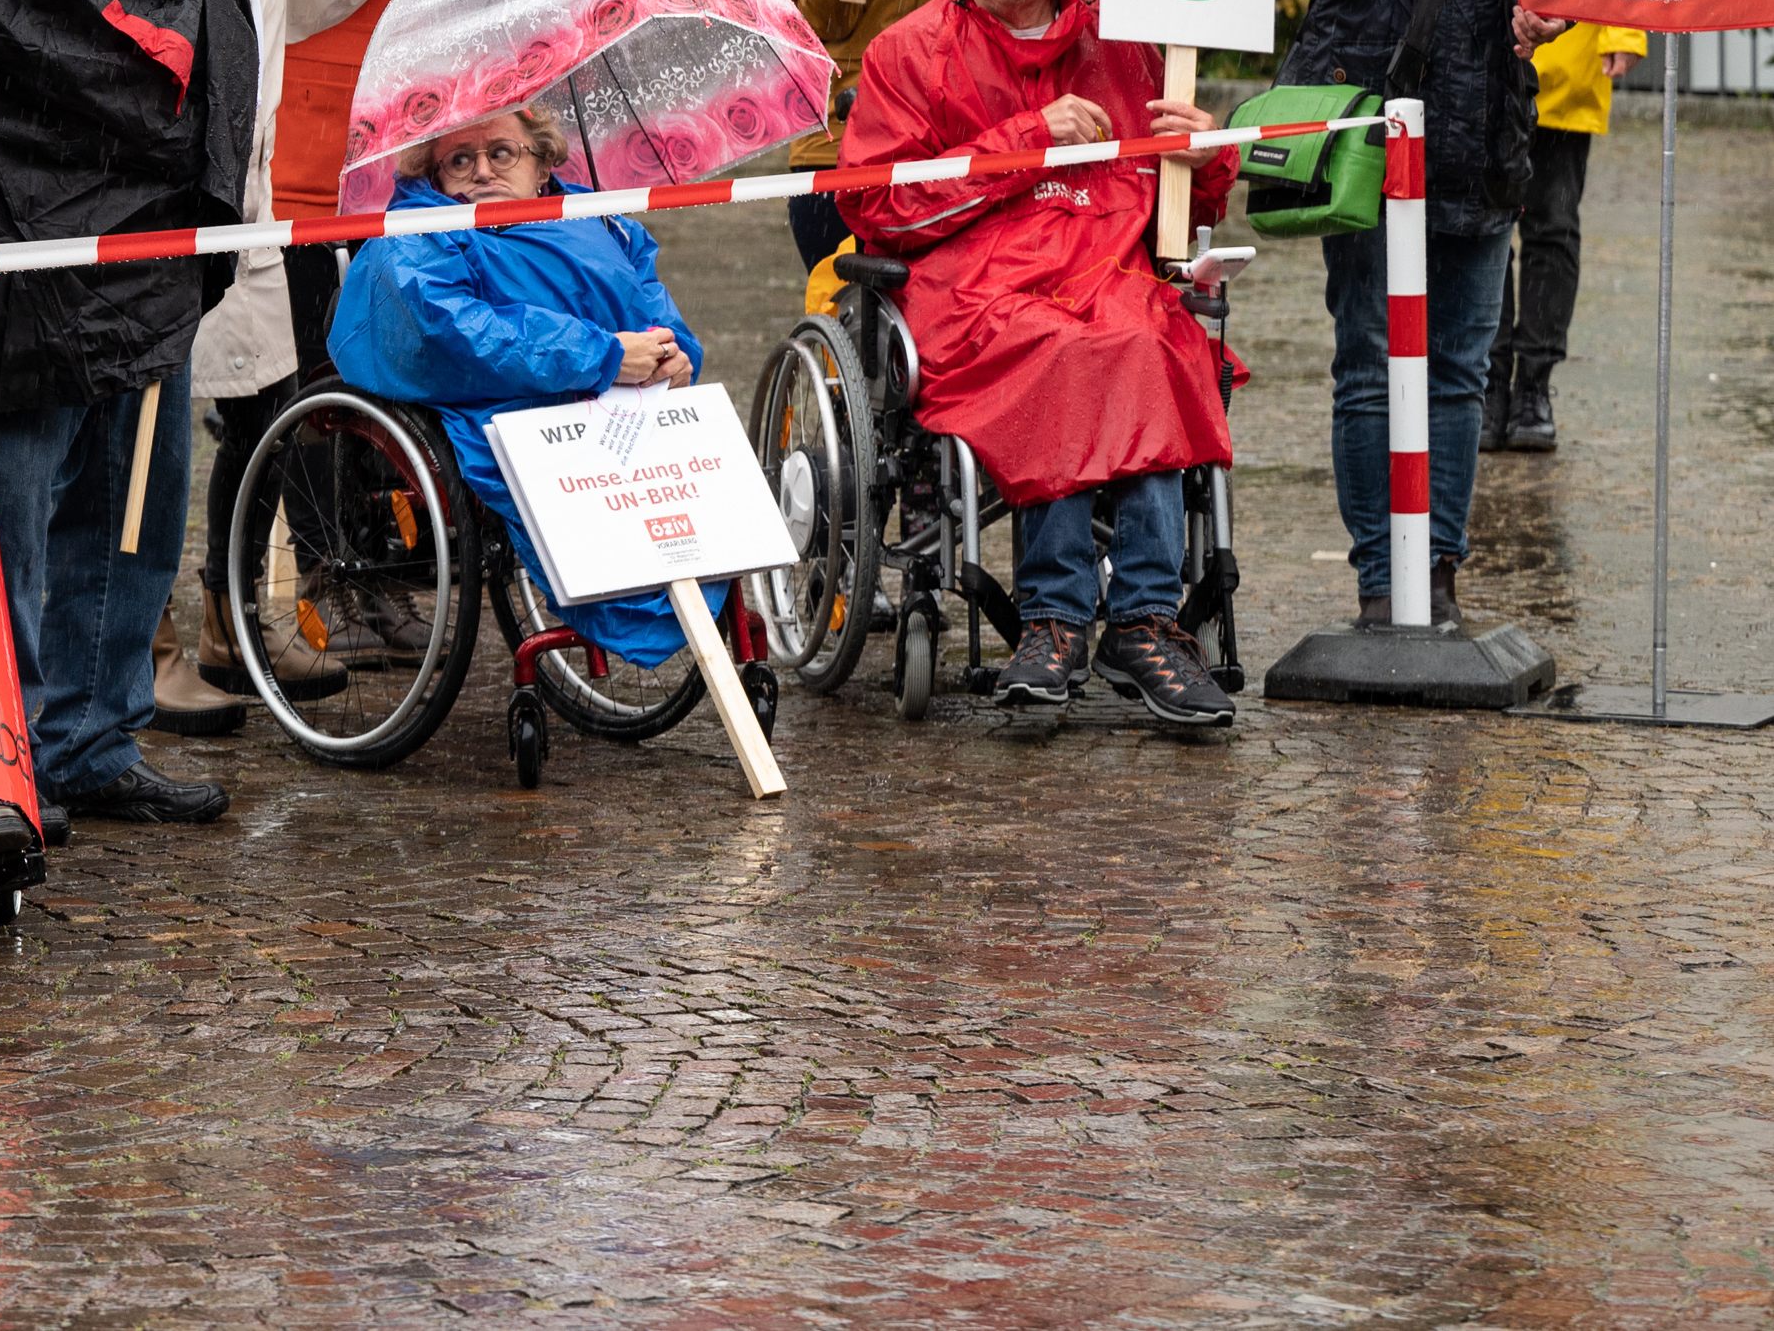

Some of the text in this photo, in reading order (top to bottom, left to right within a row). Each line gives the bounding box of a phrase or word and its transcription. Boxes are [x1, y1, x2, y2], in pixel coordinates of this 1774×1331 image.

[558, 455, 723, 494] Umsezung der
[605, 484, 701, 512] UN-BRK!
